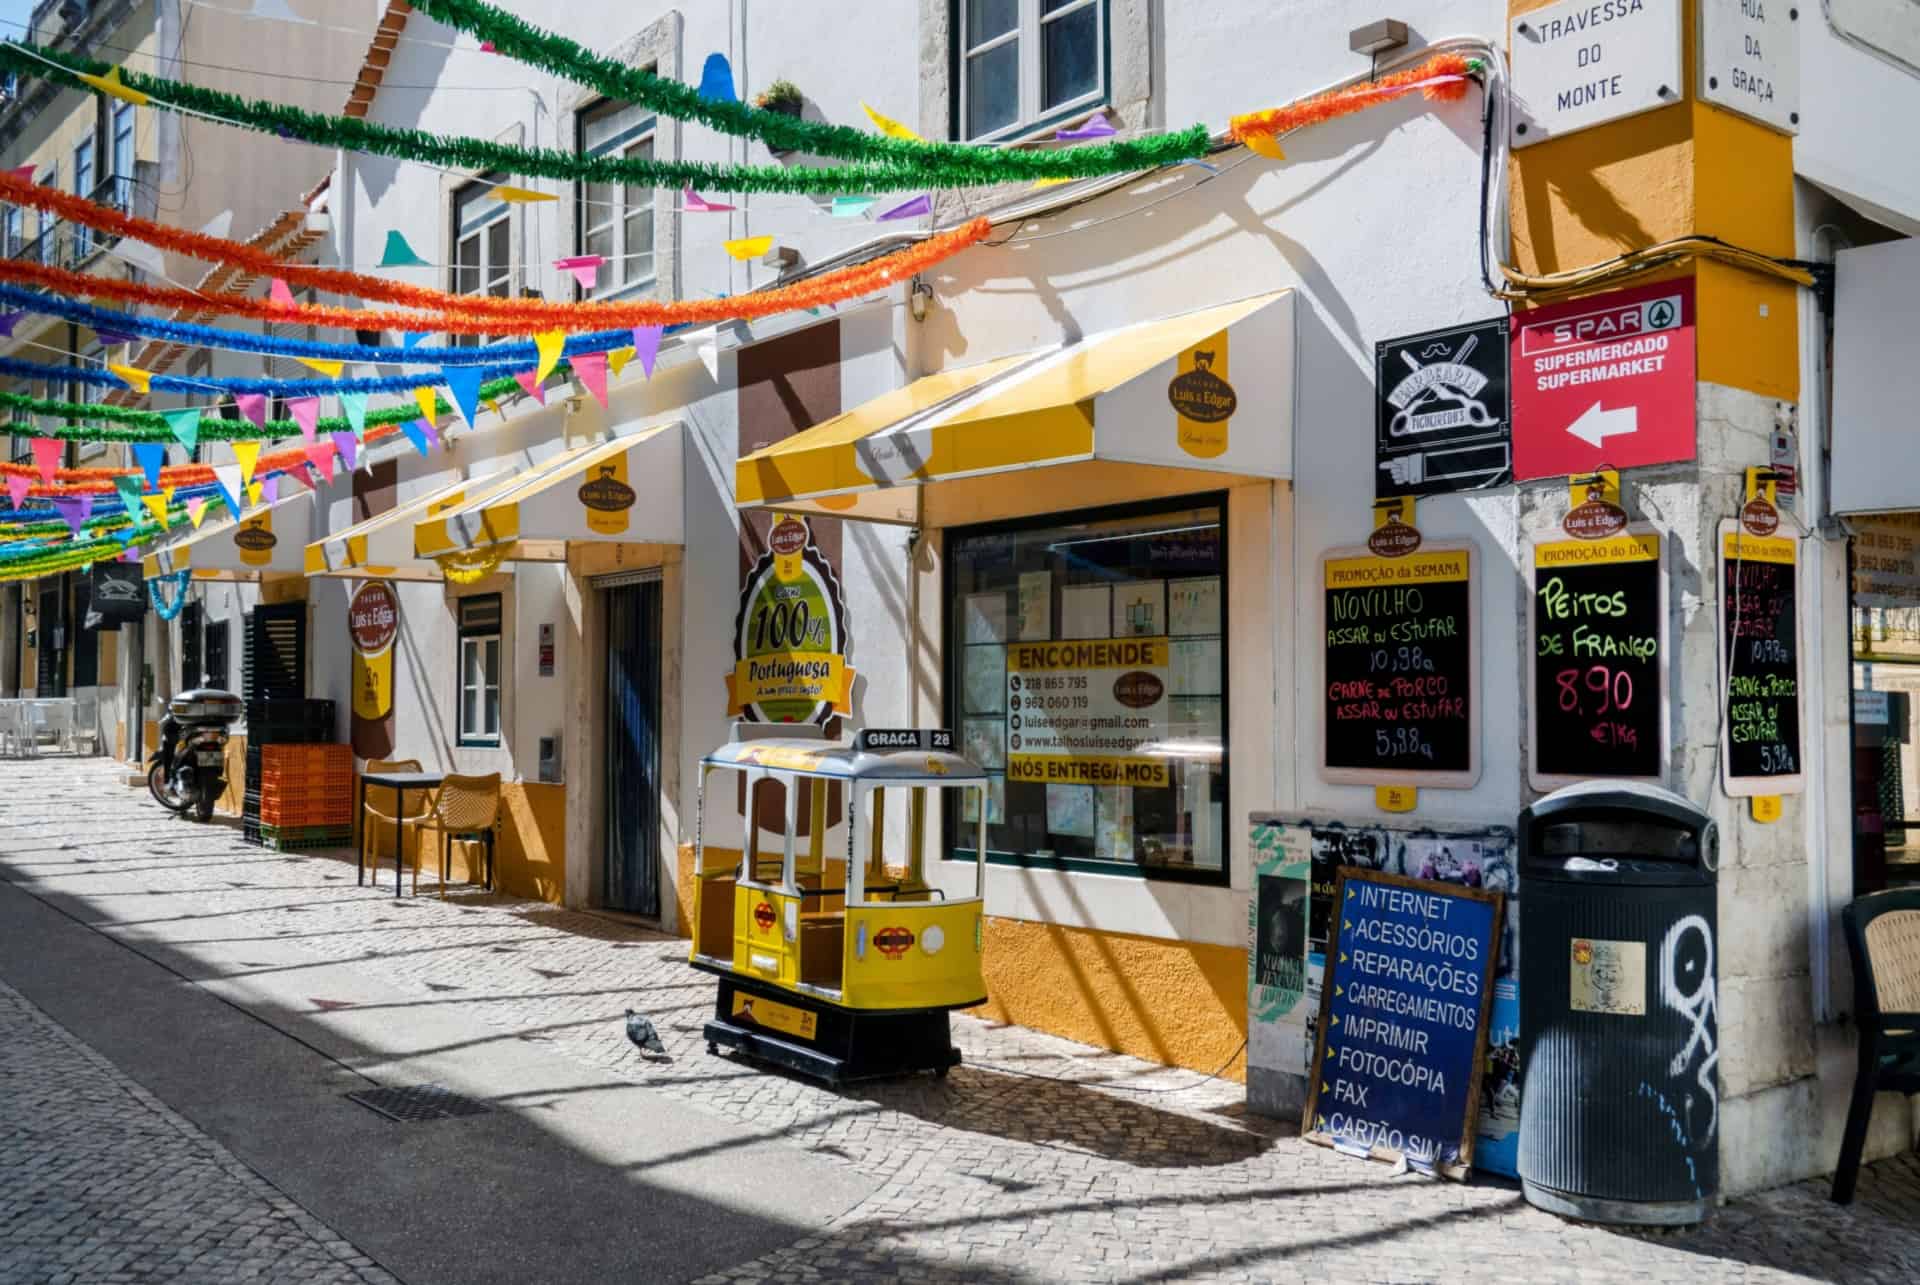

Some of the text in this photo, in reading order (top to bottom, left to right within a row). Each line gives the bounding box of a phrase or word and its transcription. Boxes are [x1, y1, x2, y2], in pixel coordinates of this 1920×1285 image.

[1540, 0, 1643, 43] TRAVESSA
[1741, 0, 1765, 23] RUA
[1578, 44, 1601, 67] DO
[1745, 35, 1762, 60] DA
[1557, 75, 1623, 111] MONTE
[1732, 68, 1774, 103] GRAÇA
[1554, 311, 1640, 343] SPAR
[1534, 335, 1669, 373] SUPERMERCADO
[1537, 355, 1665, 391] SUPERMARKET
[1203, 391, 1232, 409] Edgar
[1544, 544, 1607, 562] PROMOÇÃO
[1611, 546, 1625, 557] do
[1333, 562, 1460, 582] PROMOÇÃO da SEMANA
[373, 605, 394, 629] Edgar
[1333, 588, 1423, 622] NOVILHO
[755, 599, 825, 650] 100%
[1328, 625, 1369, 648] ASSAR
[1019, 643, 1153, 669] ENCOMENDE
[1573, 624, 1657, 664] FRANGO
[749, 658, 830, 684] Portuguesa
[1067, 676, 1088, 689] 795
[1024, 696, 1044, 709] 962
[1072, 695, 1088, 708] 119
[1337, 701, 1381, 720] ASSAR
[933, 733, 951, 746] 28
[1011, 757, 1164, 783] NÓS ENTREGAMOS
[1361, 885, 1453, 921] INTERNET
[1355, 918, 1479, 960] ACESSÓRIOS
[1352, 950, 1479, 996] REPARAÇÕES
[1348, 982, 1476, 1031] CARREGAMENTOS
[1344, 1014, 1429, 1055] IMPRIMIR
[1339, 1046, 1446, 1095] FOTOCÓPIA
[1334, 1079, 1369, 1108] FAX
[1330, 1112, 1443, 1161] CARTÃO SIM
